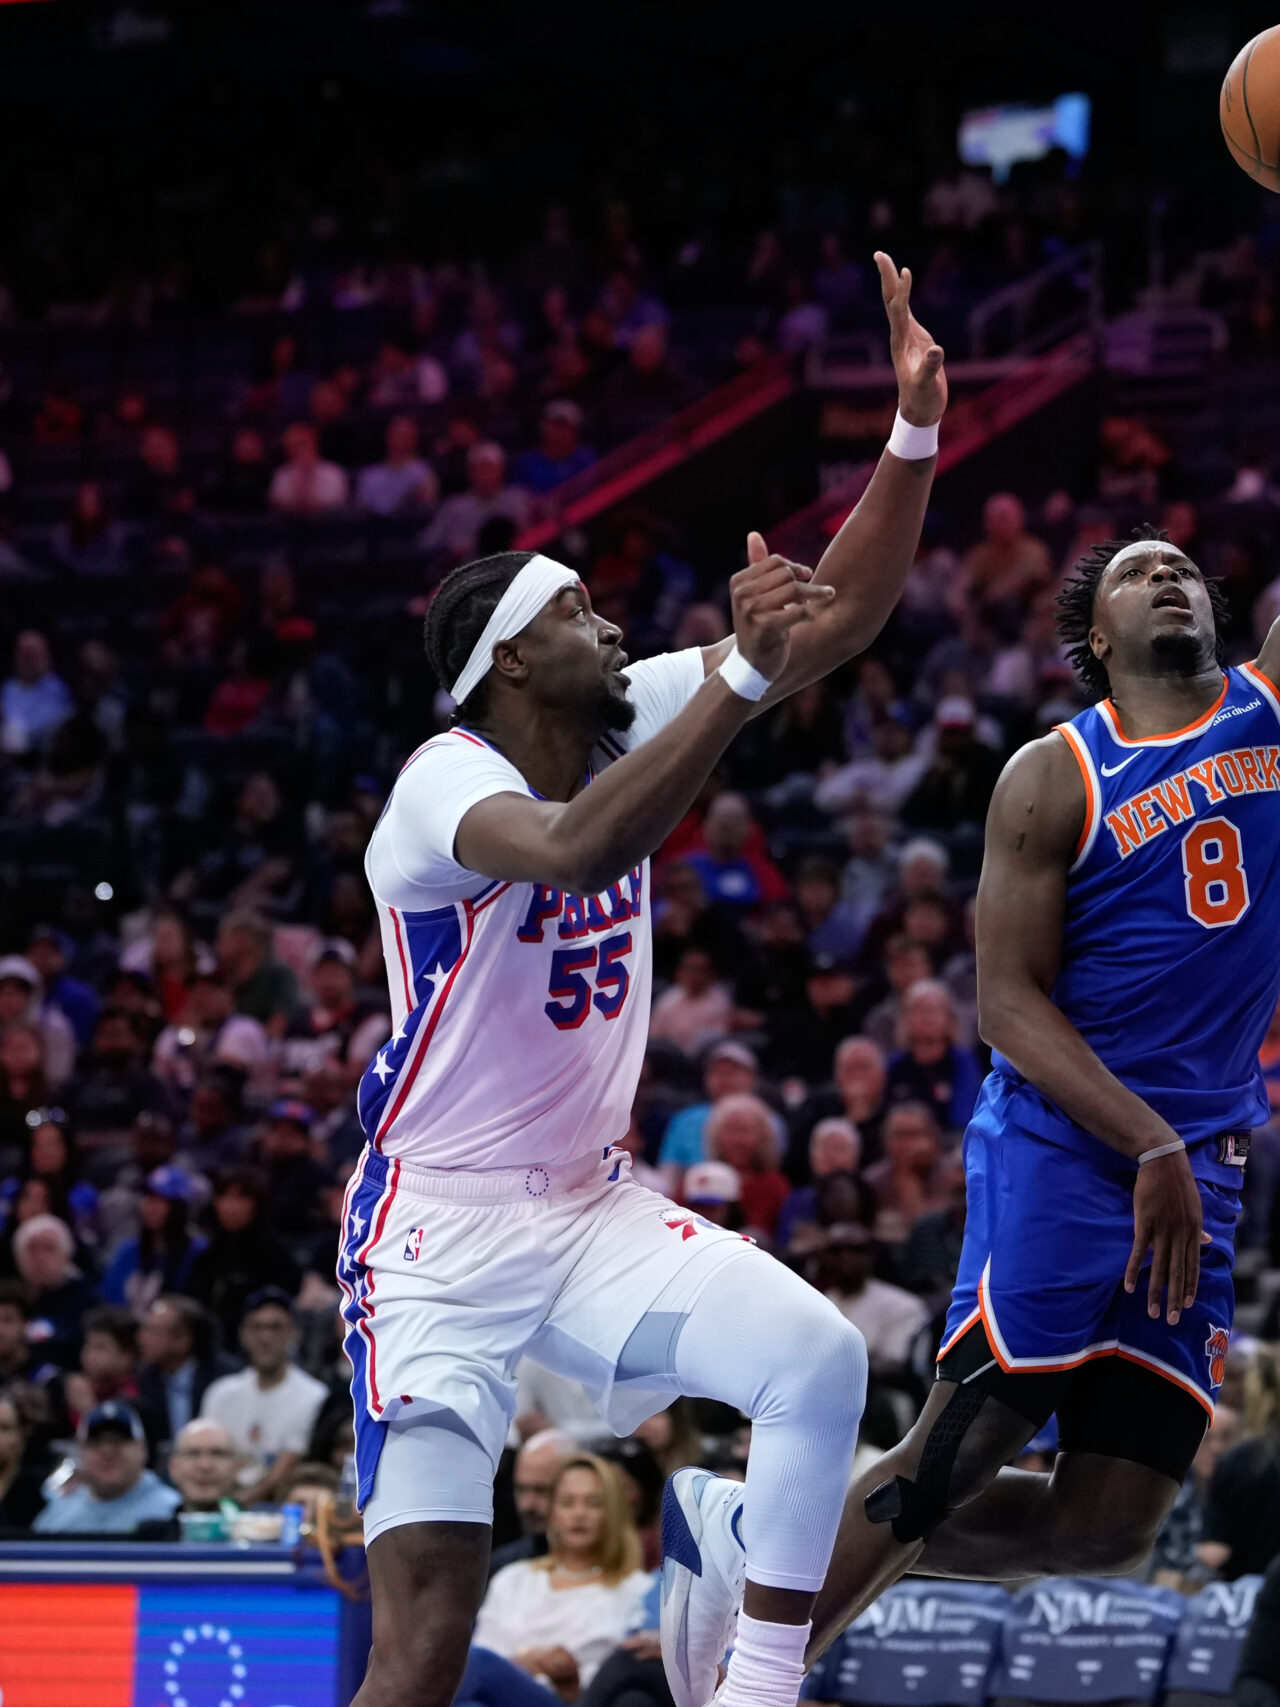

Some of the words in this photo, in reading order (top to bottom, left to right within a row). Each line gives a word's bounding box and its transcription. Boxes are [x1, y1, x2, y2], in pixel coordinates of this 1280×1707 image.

[1231, 698, 1261, 716] dhabi
[1103, 771, 1196, 861] NEW
[1181, 815, 1250, 929] 8
[545, 931, 632, 1031] 55
